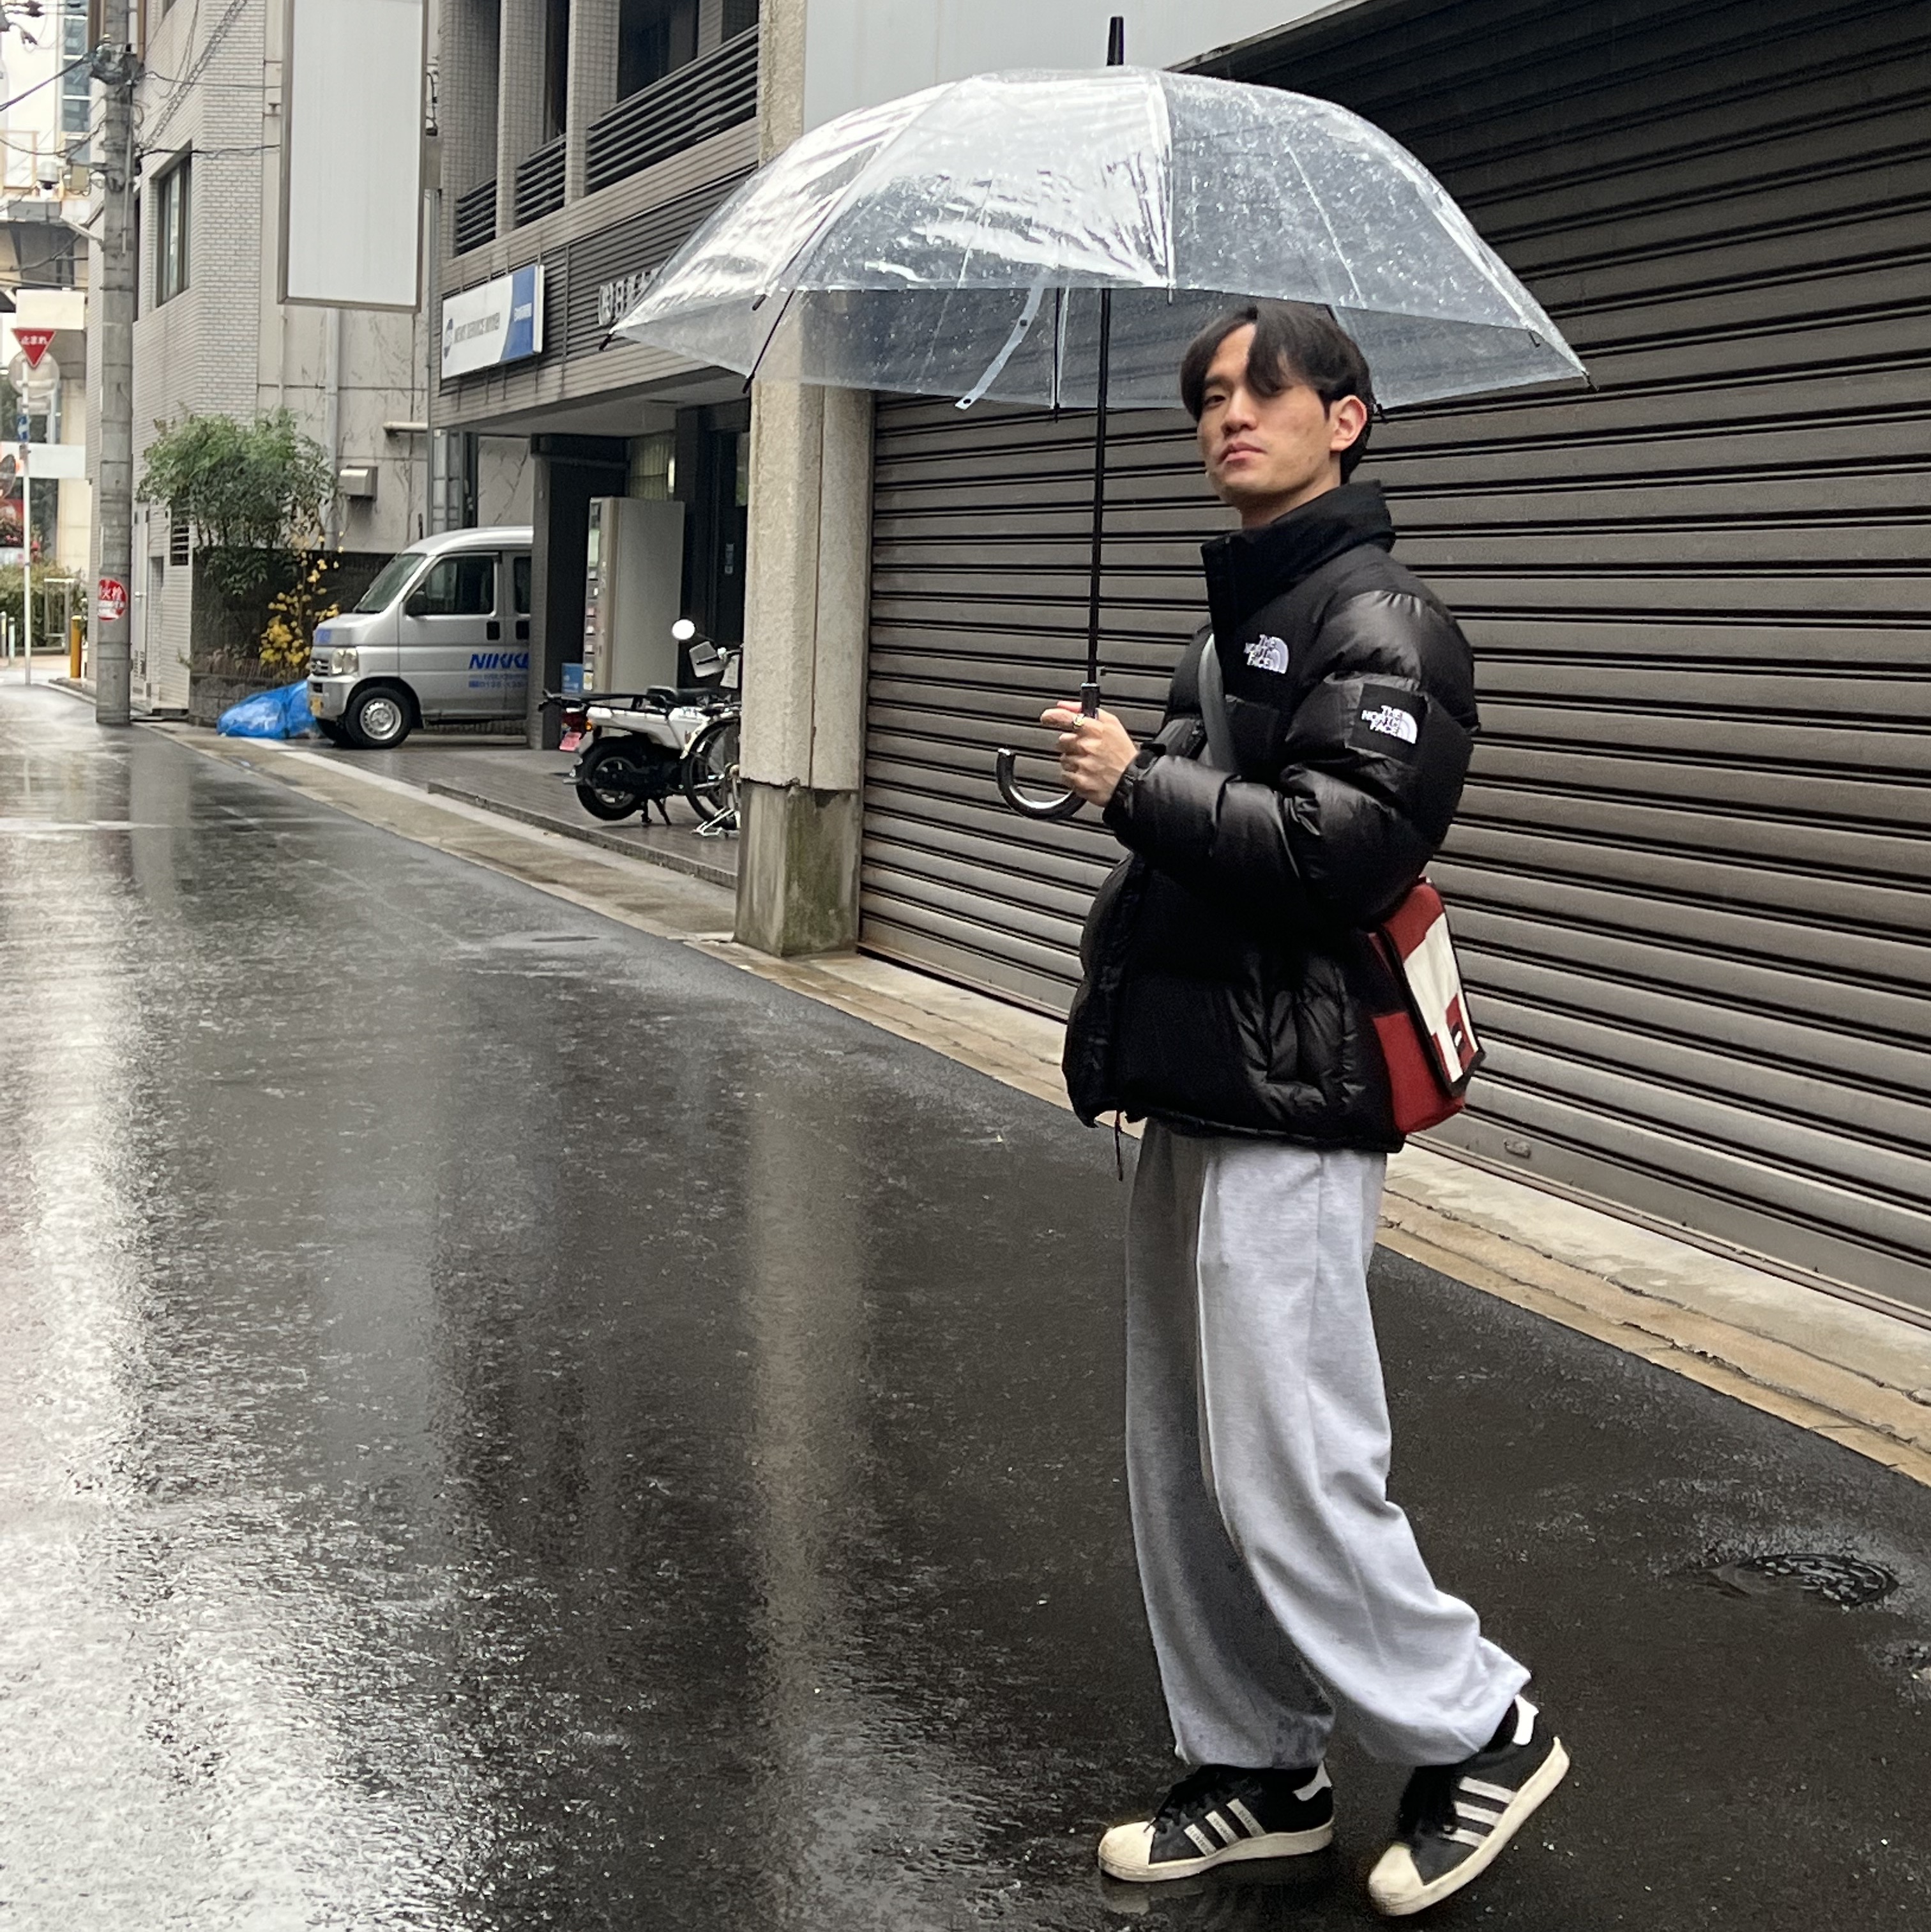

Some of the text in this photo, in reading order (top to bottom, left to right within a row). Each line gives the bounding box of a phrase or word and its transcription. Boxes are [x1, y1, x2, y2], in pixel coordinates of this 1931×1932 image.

[21, 335, 48, 345] 止まれ
[1259, 634, 1276, 648] THE
[1246, 655, 1272, 670] FACE
[1361, 710, 1400, 728] NORTH
[1381, 705, 1402, 720] THE
[1370, 720, 1398, 736] FACE
